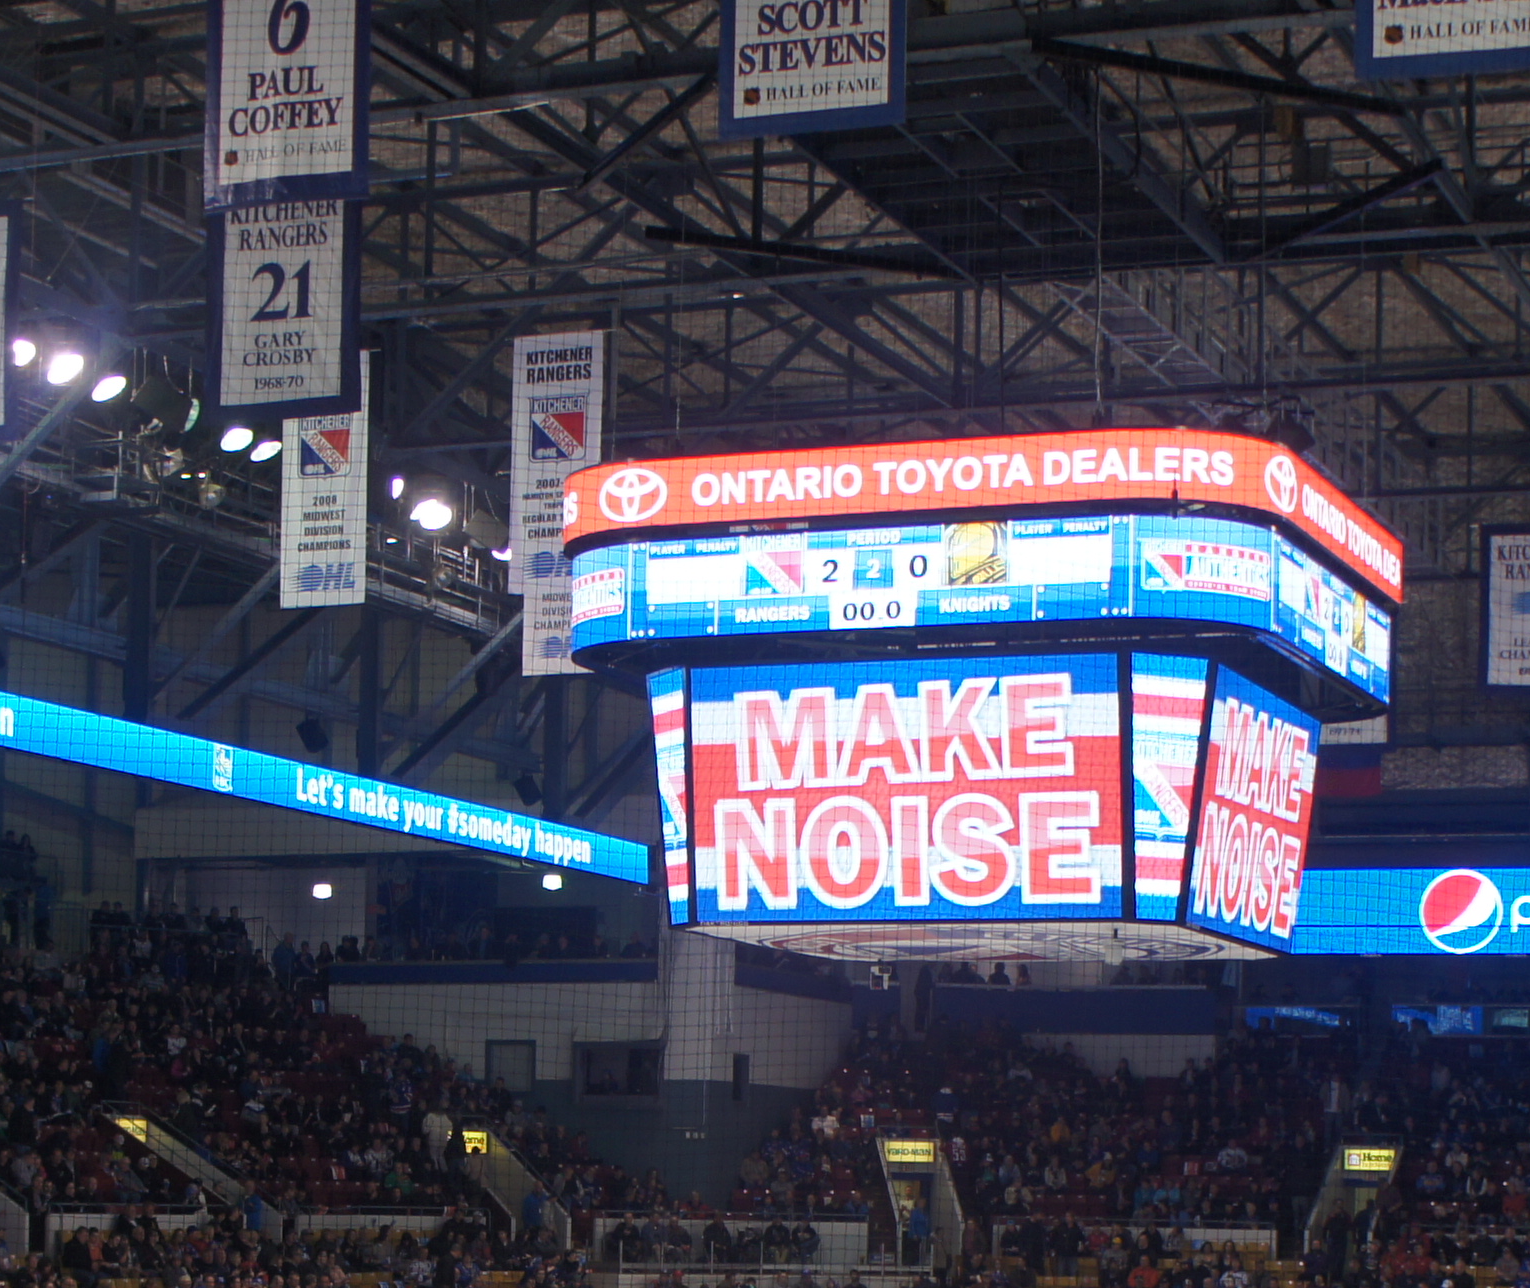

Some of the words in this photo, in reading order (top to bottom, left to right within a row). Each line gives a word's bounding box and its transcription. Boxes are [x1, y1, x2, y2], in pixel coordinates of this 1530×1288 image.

[268, 0, 310, 55] 6
[758, 0, 868, 36] SCOTT
[1409, 23, 1458, 40] HALL
[1462, 21, 1484, 35] OF
[739, 30, 886, 77] STEVENS
[248, 66, 323, 101] PAUL
[766, 85, 808, 101] HALL
[812, 83, 833, 96] OF
[837, 77, 881, 93] FAME
[229, 97, 344, 137] COFFEY
[246, 146, 278, 163] HALL
[284, 143, 304, 157] OF
[309, 139, 347, 155] FAME
[231, 200, 337, 225] KITCHENER
[240, 222, 327, 251] RANGERS
[250, 260, 313, 322] 21
[254, 330, 306, 348] GARY
[242, 348, 317, 366] CROSBY
[526, 346, 593, 366] KITCHENER
[254, 375, 303, 390] 1968-70
[526, 363, 592, 384] RANGERS
[533, 397, 584, 413] KITCHENER
[307, 432, 345, 473] RANGERS
[692, 464, 862, 506] ONTARIO
[873, 452, 1034, 495] TOYOTA
[1043, 447, 1234, 485] DEALERS
[312, 495, 337, 506] 2008
[303, 509, 346, 521] MIDWEST
[304, 525, 343, 536] DIVISION
[848, 530, 900, 546] PERIOD
[1302, 484, 1346, 544] ONTARIO
[1347, 519, 1383, 575] TOYOTA
[297, 540, 351, 552] CHAMPIONS
[292, 562, 356, 592] OHL
[823, 559, 838, 582] 2
[909, 555, 928, 578] 0
[735, 605, 810, 623] RANGERS
[939, 594, 1010, 614] KNIGHTS
[735, 673, 1075, 792] MAKE
[1215, 696, 1310, 823] MAKE
[297, 767, 344, 807] Let's
[350, 787, 398, 820] make
[403, 801, 443, 831] your
[448, 803, 531, 857] #someday
[535, 821, 591, 865] happen
[714, 789, 1100, 910] NOISE
[1197, 802, 1299, 938] NOISE
[1363, 1153, 1392, 1163] Home
